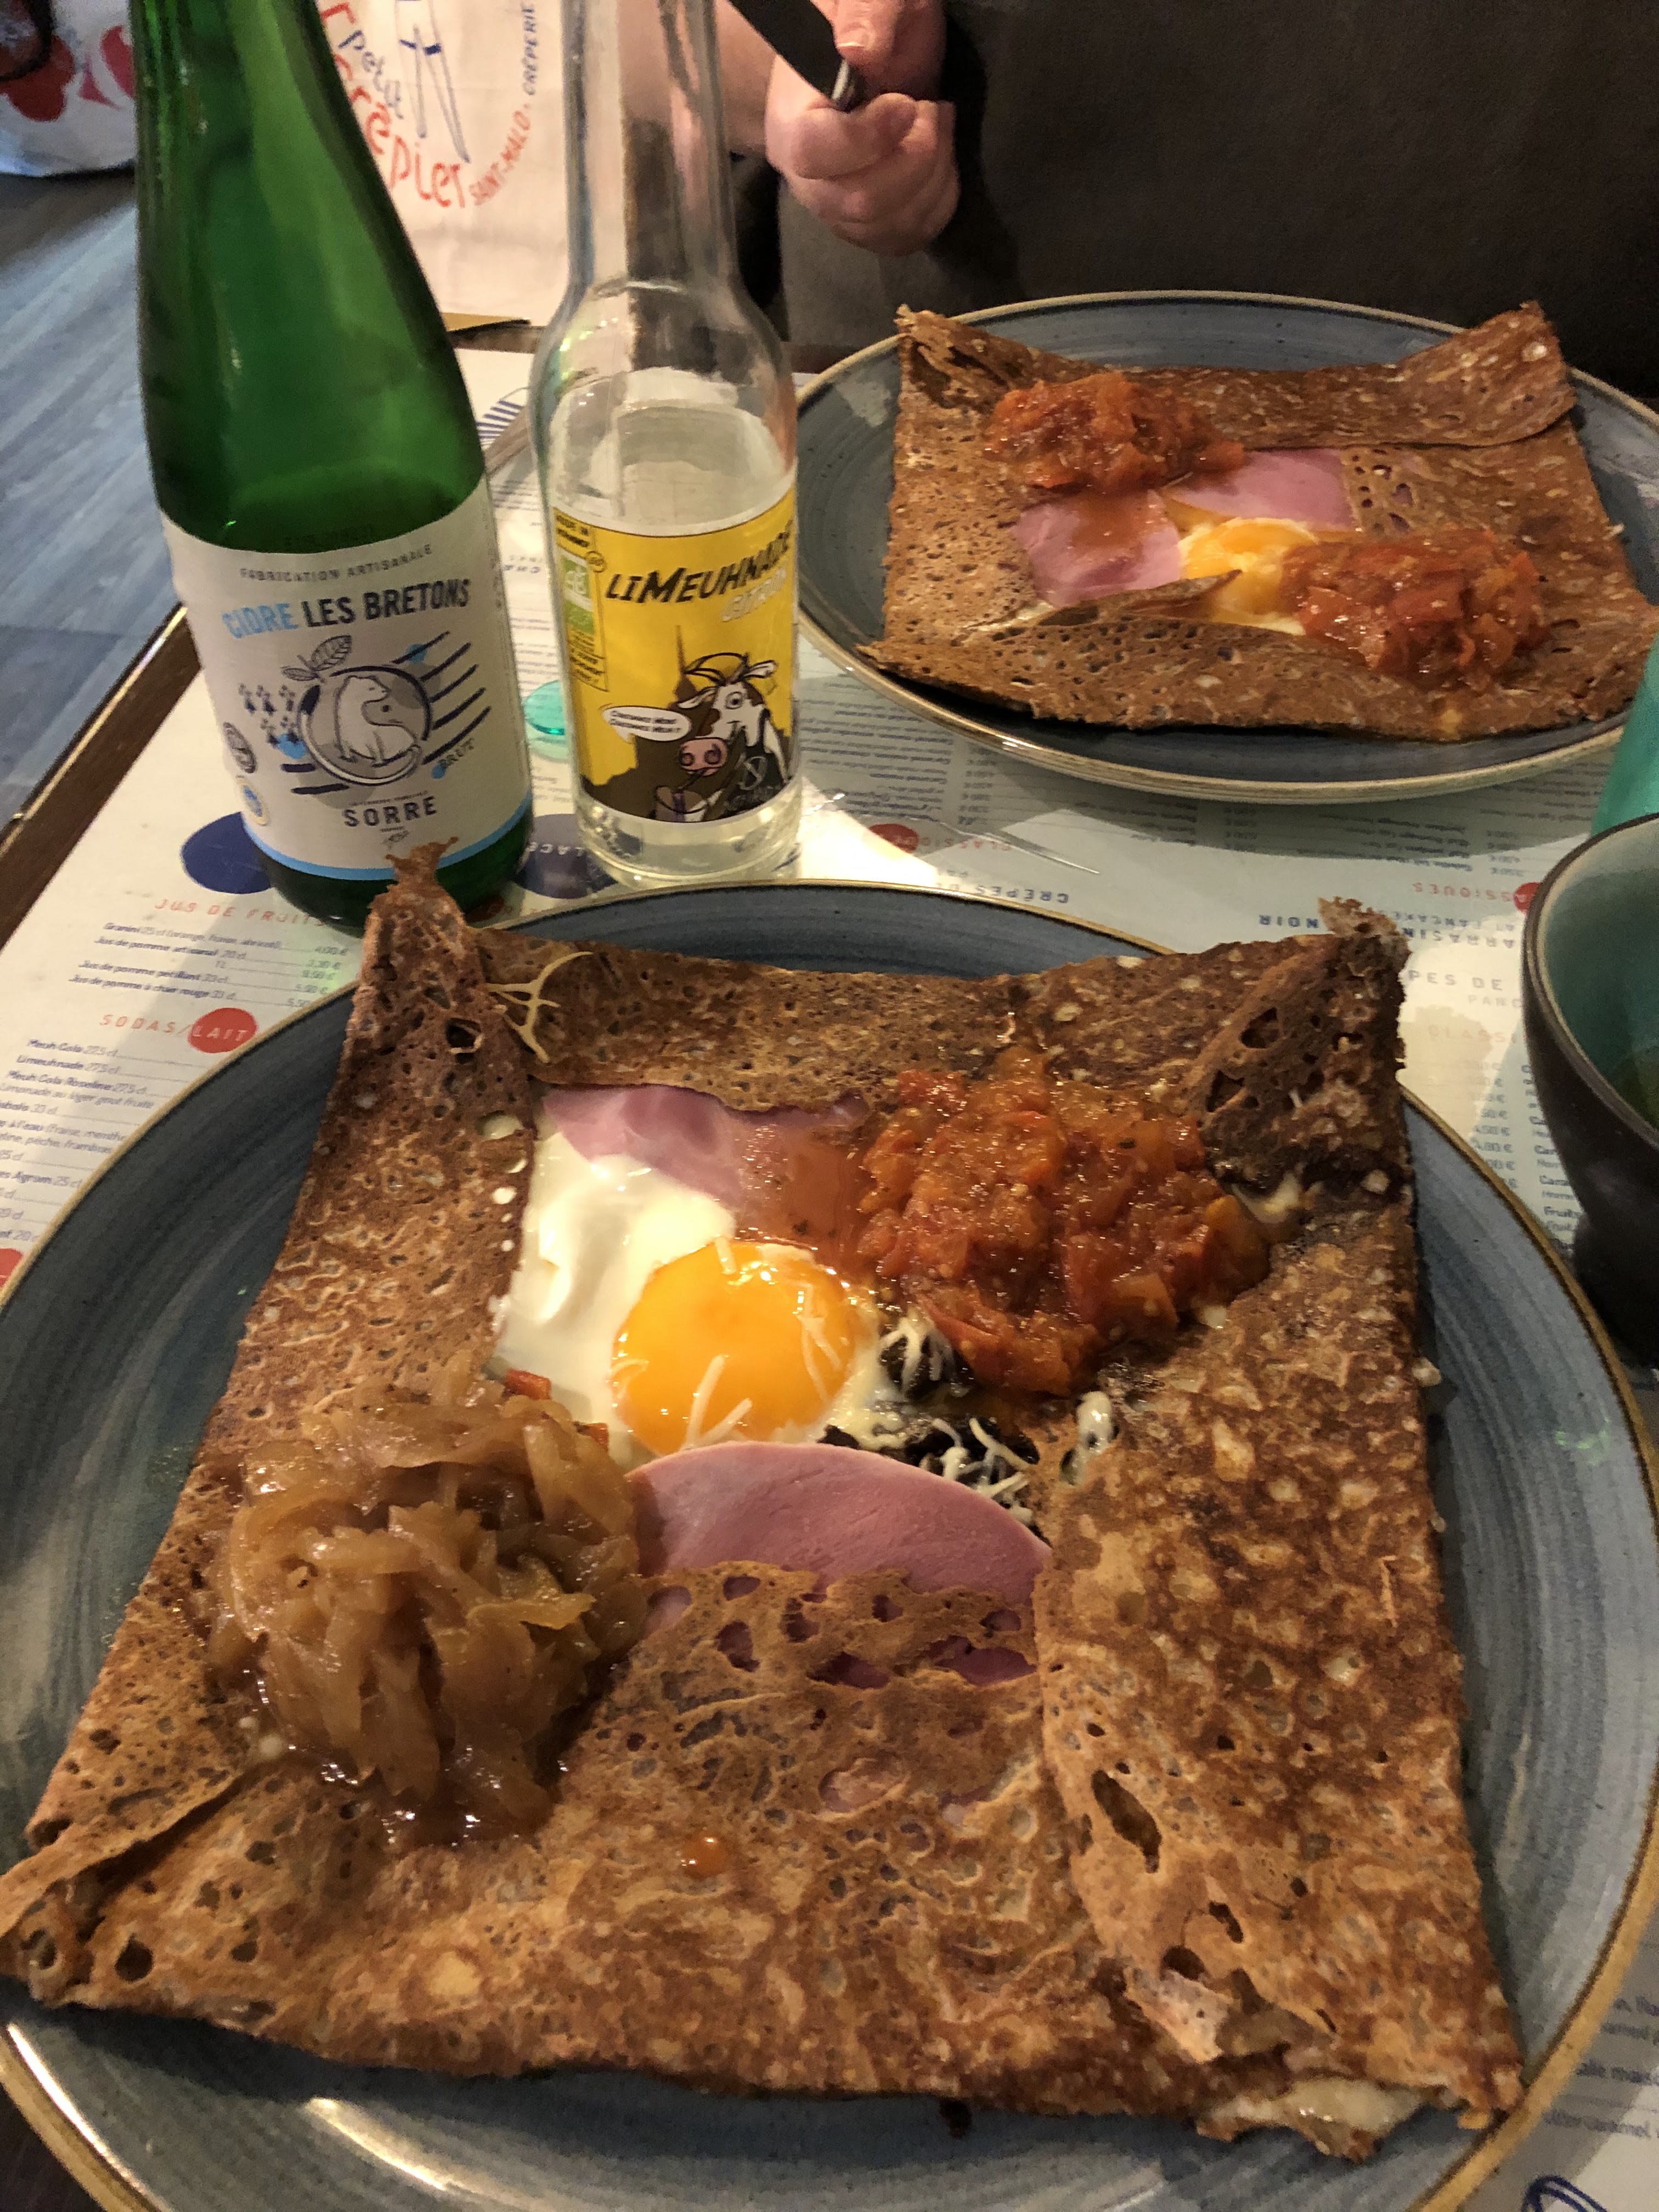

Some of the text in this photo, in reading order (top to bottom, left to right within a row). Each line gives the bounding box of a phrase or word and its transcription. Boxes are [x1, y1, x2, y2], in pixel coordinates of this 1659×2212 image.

[240, 544, 432, 583] FABRICATION ARTISANALE
[222, 578, 472, 639] CIDRE LES BRETONS
[342, 795, 438, 827] SORRE
[974, 884, 1069, 904] CRÊPES
[155, 899, 198, 913] JUS
[207, 905, 236, 917] DE
[1259, 915, 1515, 949] ARRASIN NOIR
[1407, 969, 1503, 991] PES DE
[1468, 994, 1522, 1008] PANC
